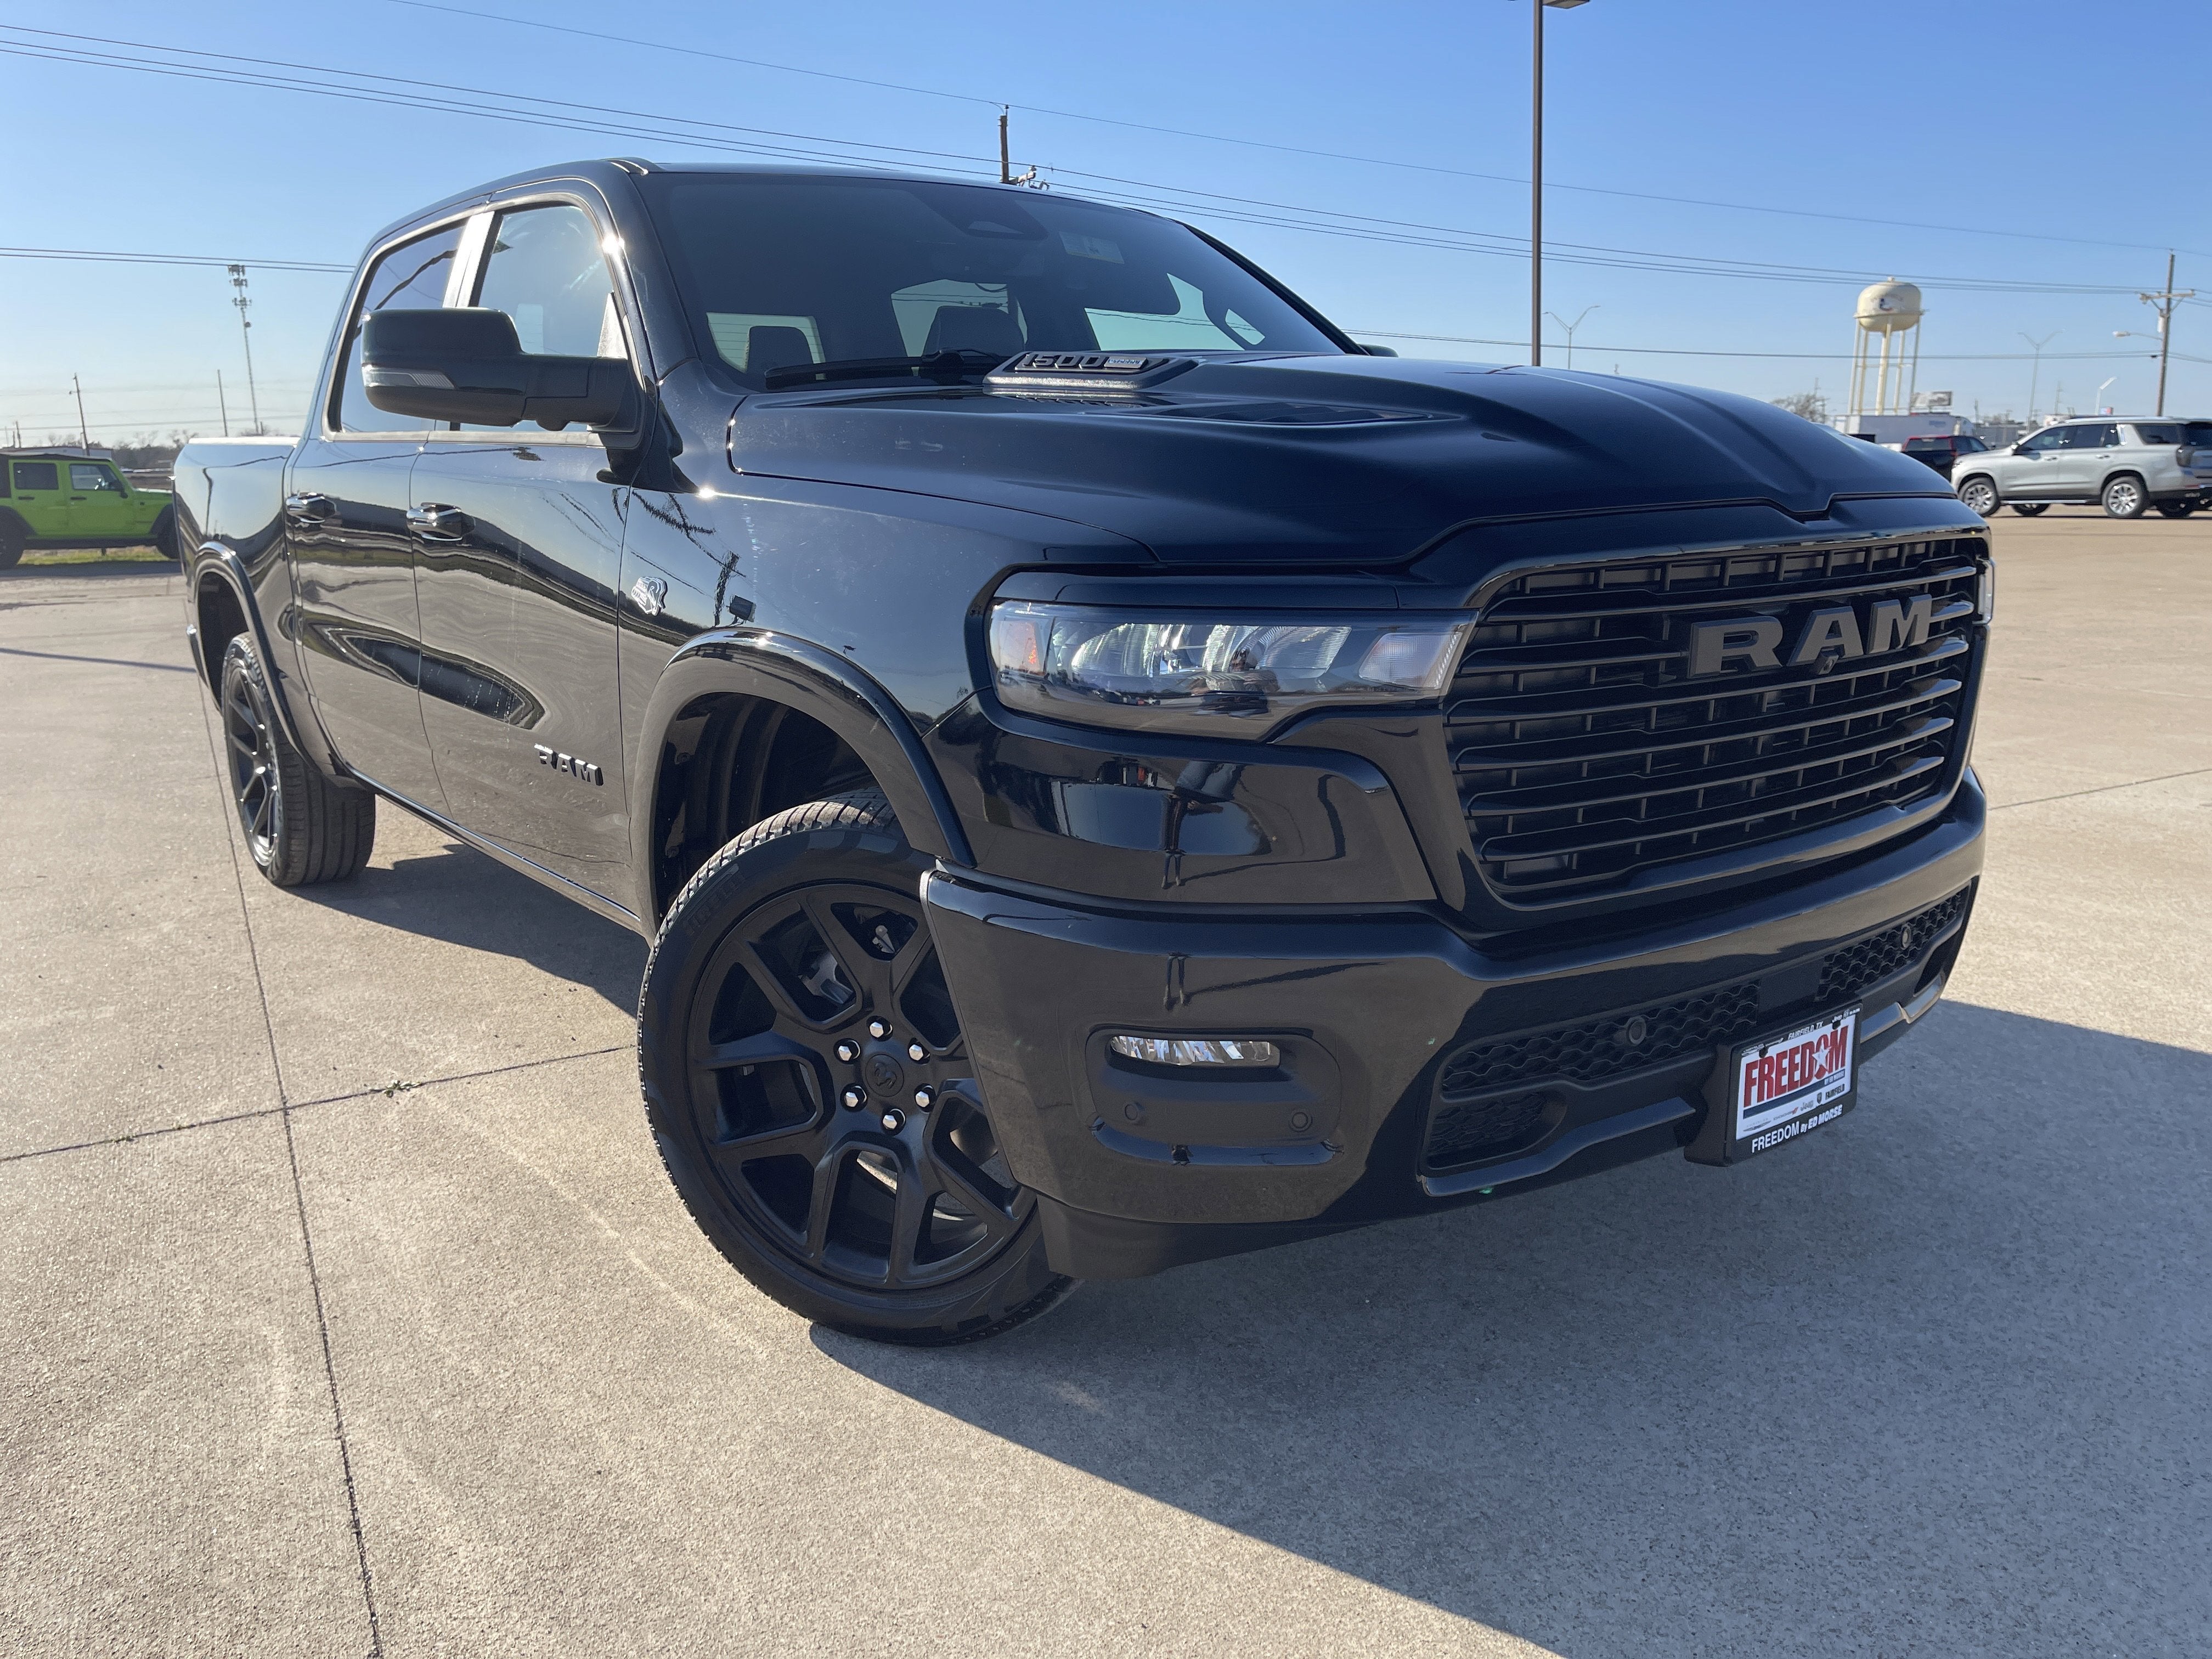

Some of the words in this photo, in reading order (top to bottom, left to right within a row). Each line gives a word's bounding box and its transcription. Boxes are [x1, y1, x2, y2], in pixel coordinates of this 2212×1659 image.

[1022, 353, 1105, 368] 1500
[1687, 594, 1932, 679] RAM
[534, 743, 603, 786] RAM
[1816, 1021, 1824, 1030] TX
[1743, 1025, 1849, 1108] FREEDOM
[1833, 1071, 1844, 1080] MORSE
[1825, 1084, 1845, 1101] FAIRFIELD
[1801, 1100, 1814, 1111] Jeep
[1752, 1121, 1799, 1153] FREEDOM
[1808, 1116, 1818, 1129] ED
[1818, 1104, 1843, 1125] MORSE
